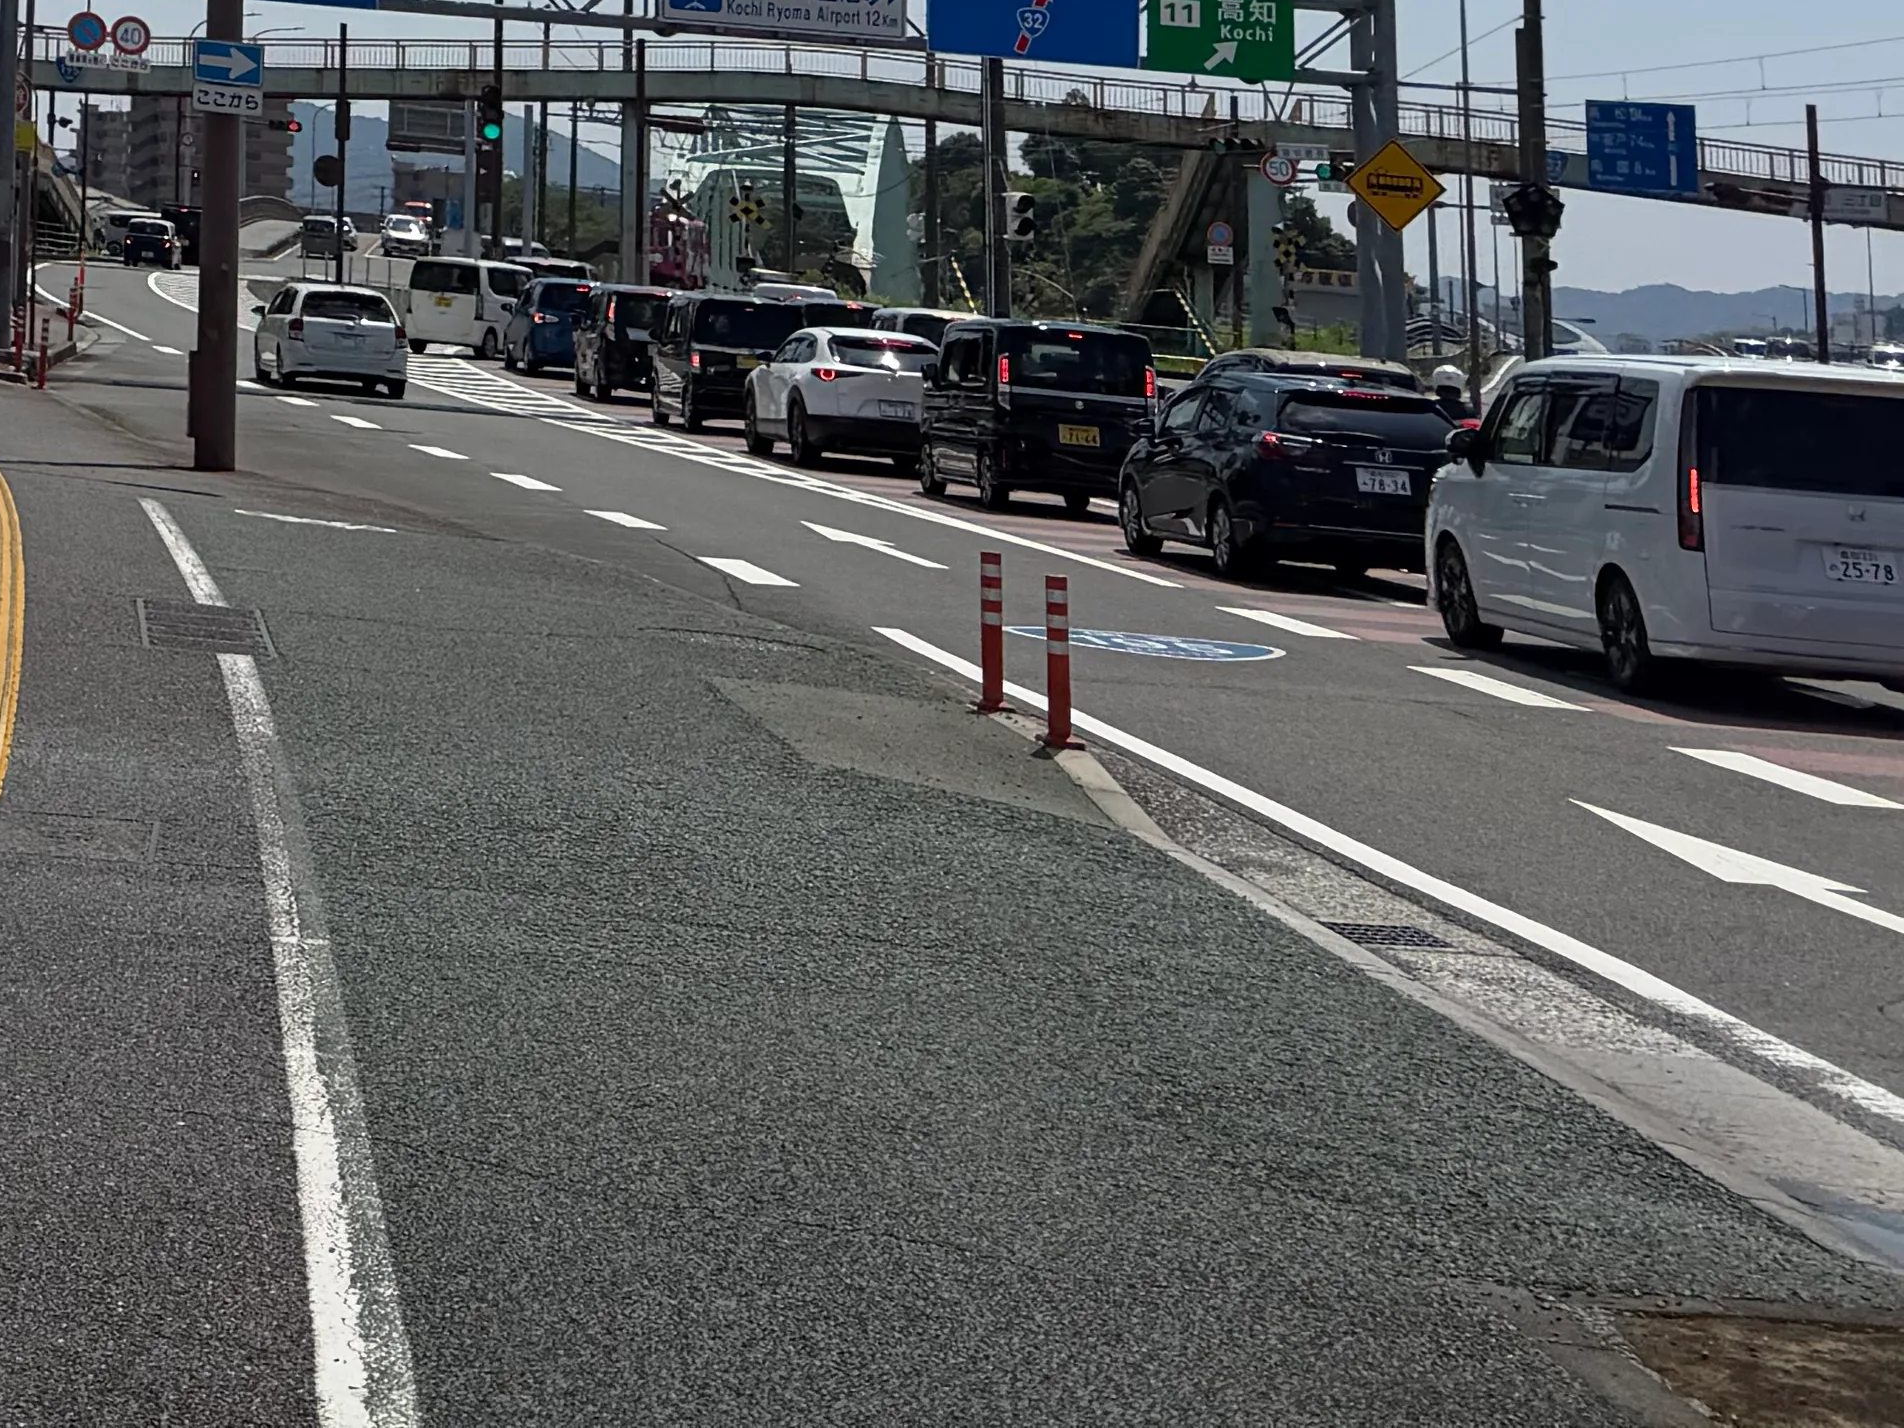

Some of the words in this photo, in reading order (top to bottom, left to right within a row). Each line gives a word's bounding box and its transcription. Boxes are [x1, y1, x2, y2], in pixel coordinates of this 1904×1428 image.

[726, 0, 762, 17] Kochi
[768, 3, 811, 22] Ryoma
[816, 6, 861, 26] Airport
[1023, 12, 1043, 28] 32
[1163, 2, 1195, 23] 11
[120, 27, 142, 45] 40
[1220, 24, 1274, 42] Kochi
[197, 89, 259, 110] ここから
[1269, 160, 1289, 176] 50
